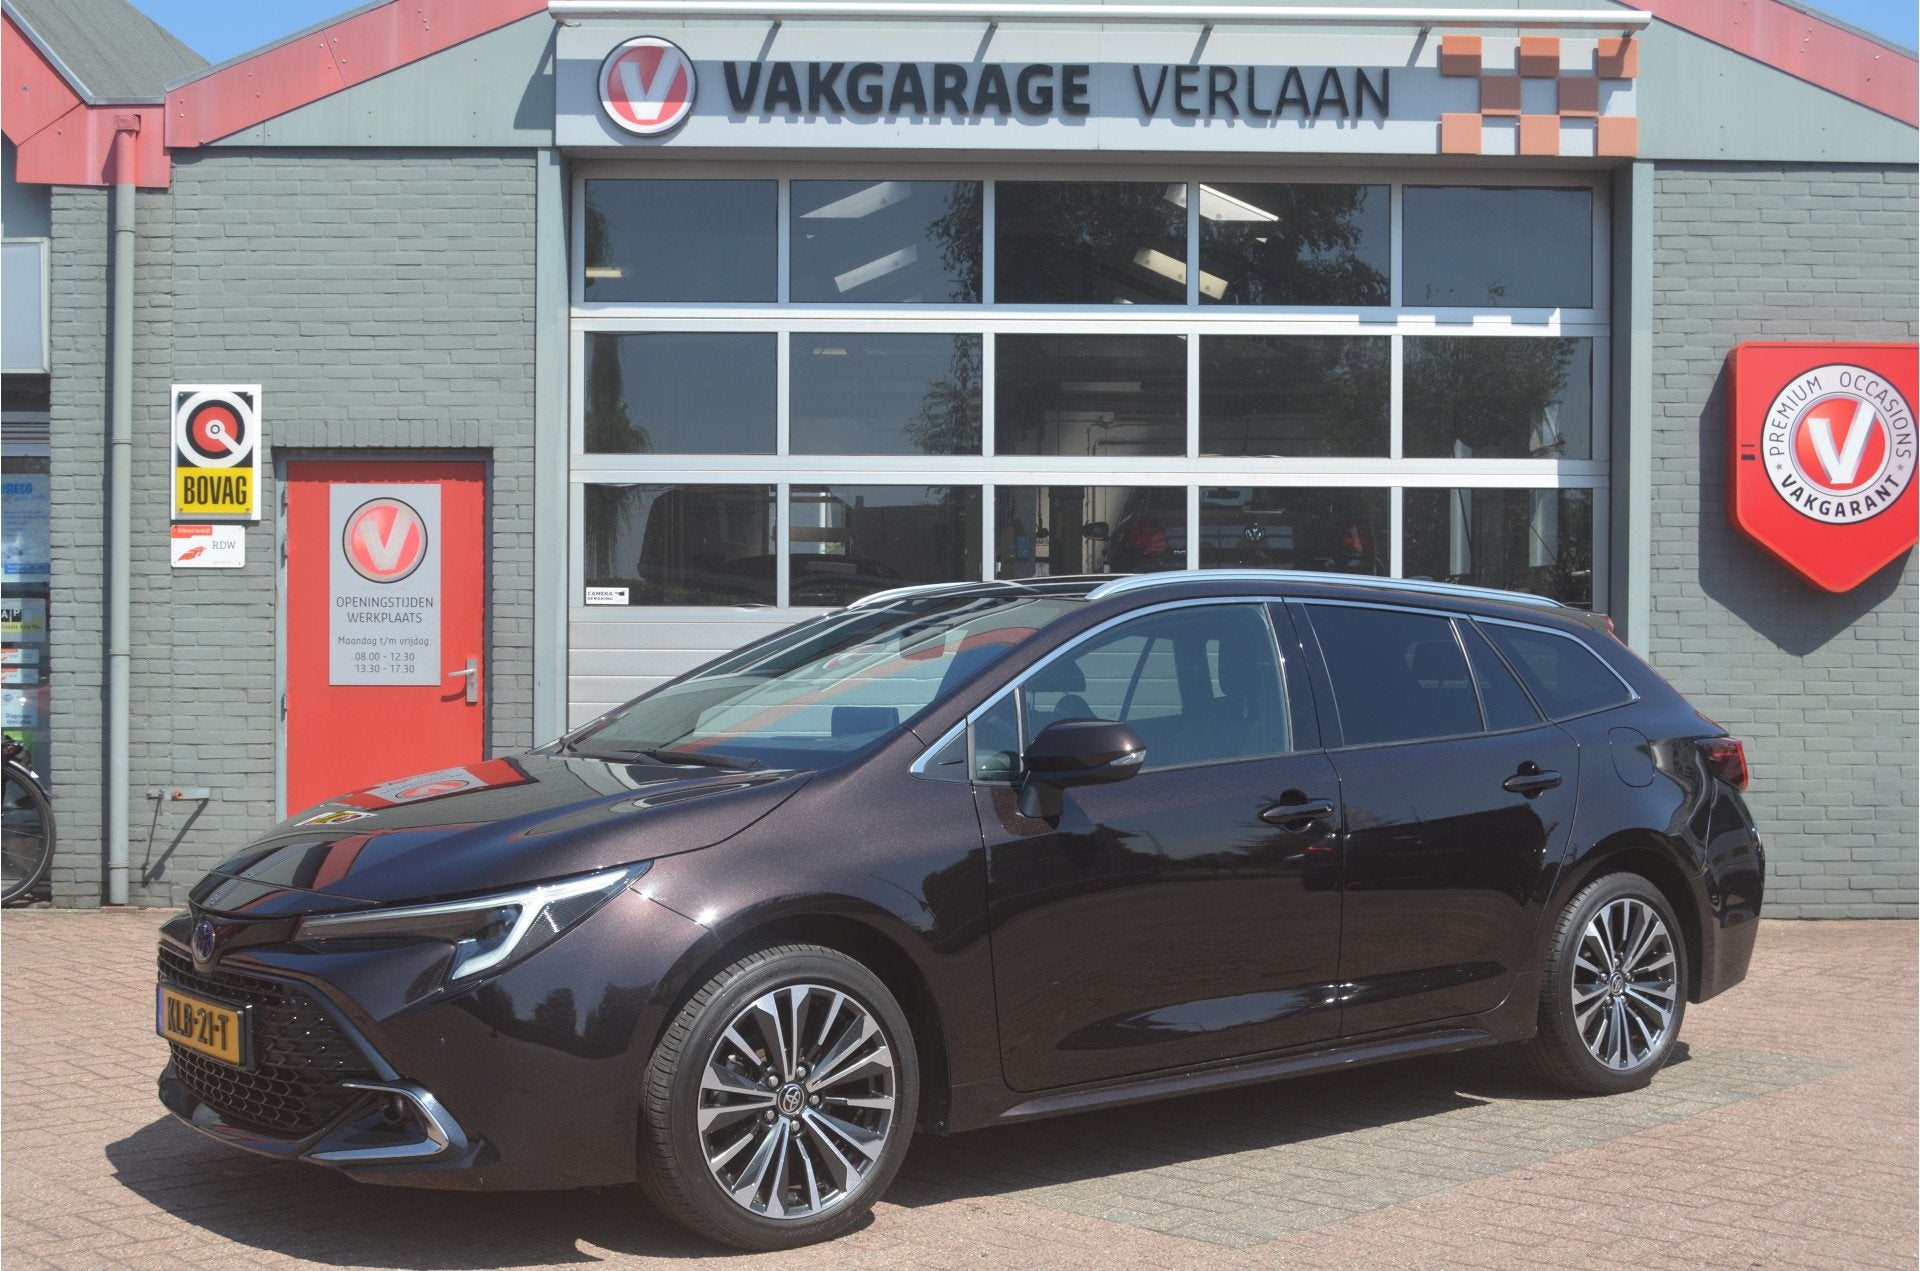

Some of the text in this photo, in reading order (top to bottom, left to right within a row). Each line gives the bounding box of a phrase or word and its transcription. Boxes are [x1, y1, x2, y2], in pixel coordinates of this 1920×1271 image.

[723, 61, 1390, 118] VAKGARAGE VERLAAN
[1769, 371, 1912, 459] PREMIUM OCCASIONS
[183, 475, 247, 505] BOVAG
[1780, 473, 1900, 518] VAKGARANT
[212, 541, 236, 549] RDW
[336, 596, 434, 608] OPENINGSTIJDEN
[347, 612, 423, 623] WERKPLAATS
[338, 636, 377, 647] Maandag
[380, 636, 397, 646] t/m
[355, 652, 380, 661] 08.00
[390, 652, 415, 661] 12.30
[355, 664, 380, 673] 13.30
[390, 664, 415, 673] 17.30
[167, 996, 229, 1051] KLB-21-T
